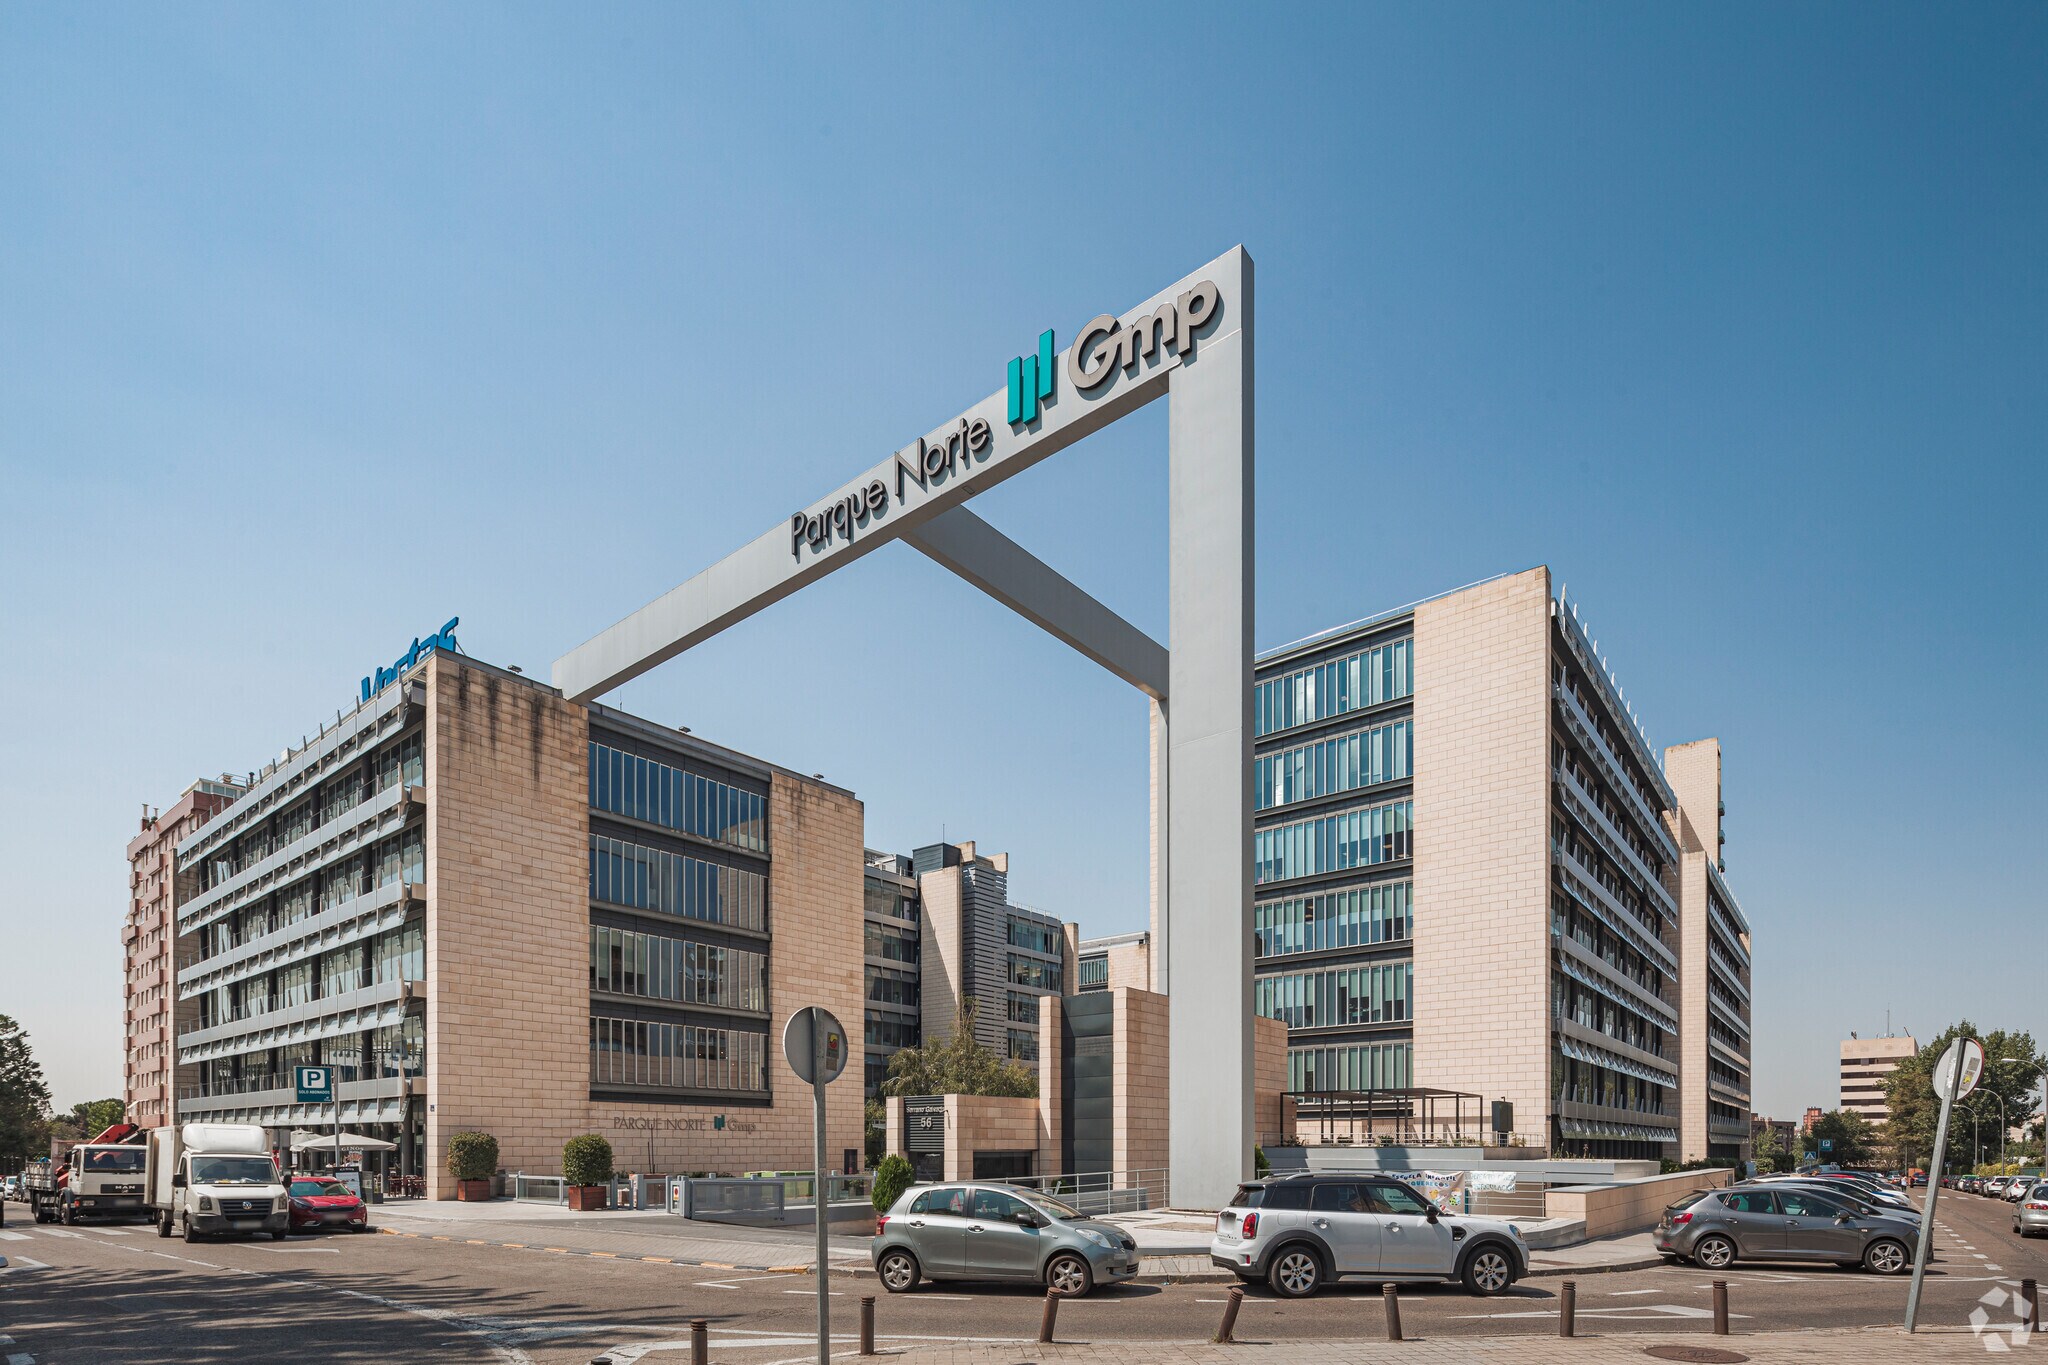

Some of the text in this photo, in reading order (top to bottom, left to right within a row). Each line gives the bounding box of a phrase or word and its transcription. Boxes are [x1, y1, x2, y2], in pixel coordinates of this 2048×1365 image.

[790, 279, 1220, 556] Parque Norte Gmp
[307, 1071, 321, 1086] P
[613, 1116, 757, 1134] PARQUE NORTE Gmp
[920, 1117, 932, 1128] 56
